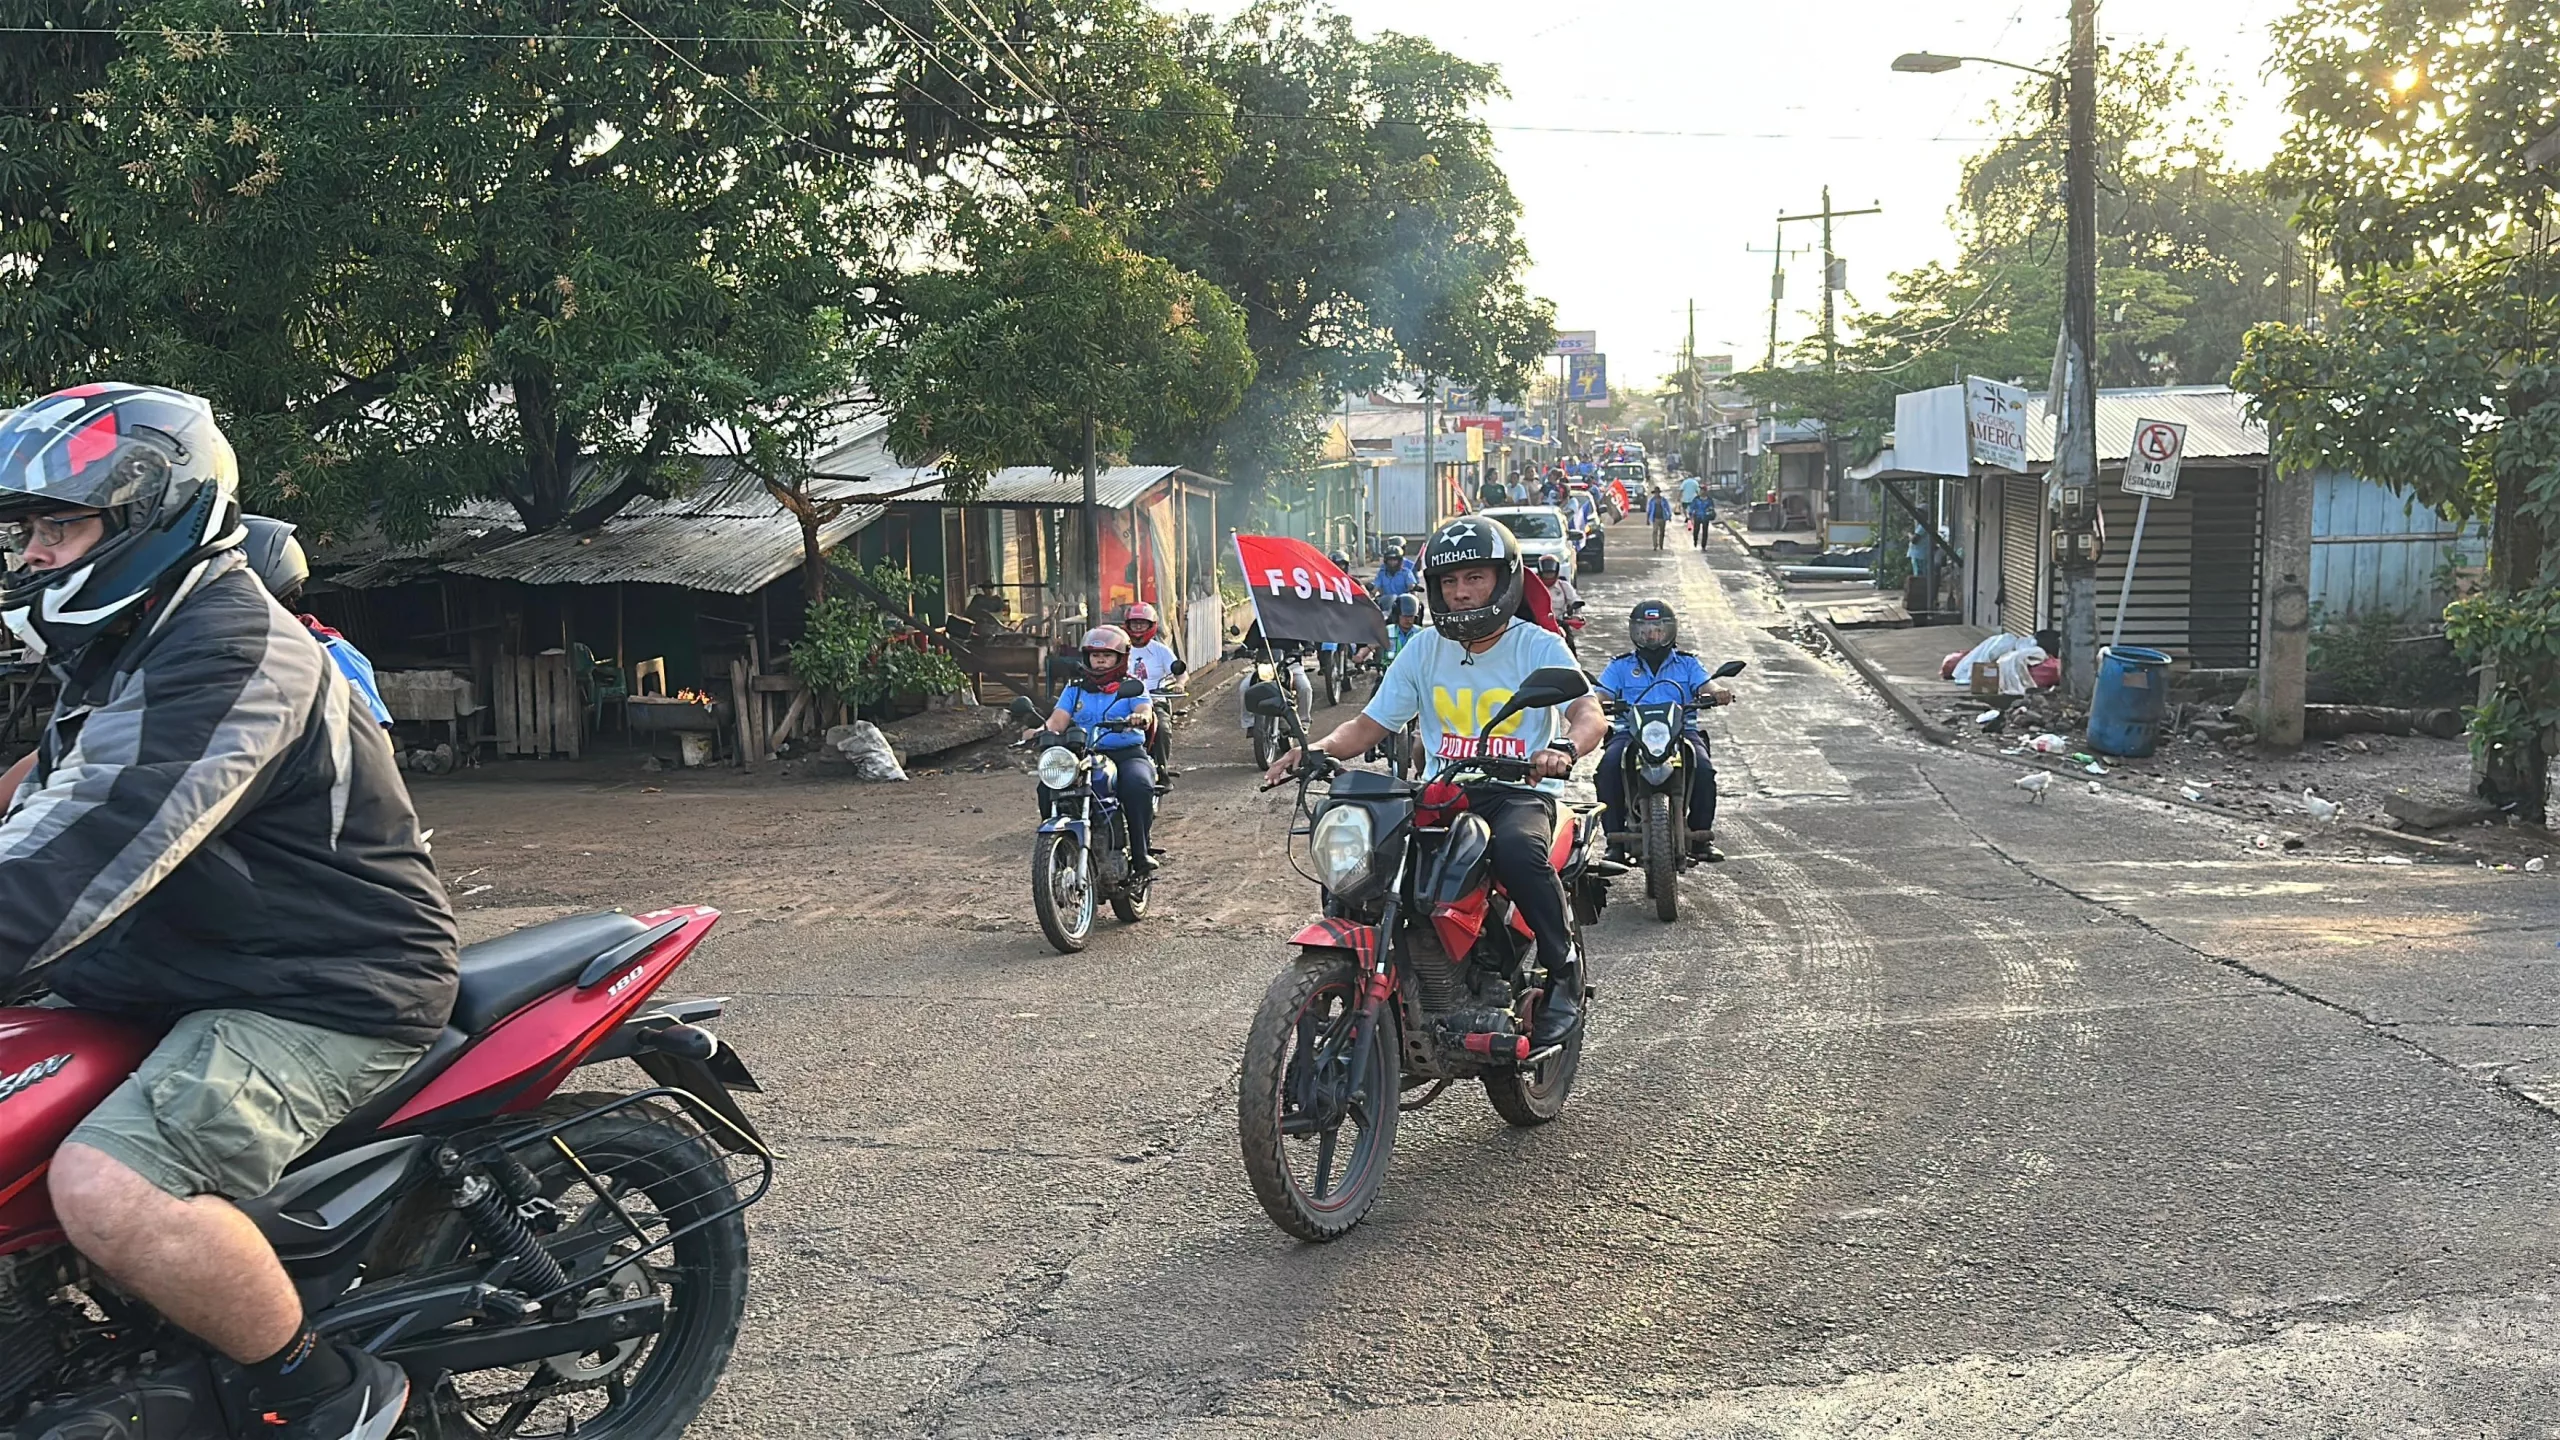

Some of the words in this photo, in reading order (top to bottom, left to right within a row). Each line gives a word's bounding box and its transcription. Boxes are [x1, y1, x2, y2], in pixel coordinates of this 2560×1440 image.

[1977, 412, 2015, 431] SEGUROS
[1968, 421, 2024, 451] AMERICA
[2144, 462, 2161, 474] NO
[2127, 475, 2172, 490] ESTACIONAR
[1431, 548, 1480, 567] MIKHAIL
[1264, 567, 1354, 605] FSLN
[1433, 686, 1523, 737] NO
[1439, 736, 1526, 758] PUDIEON.
[607, 965, 644, 997] 180
